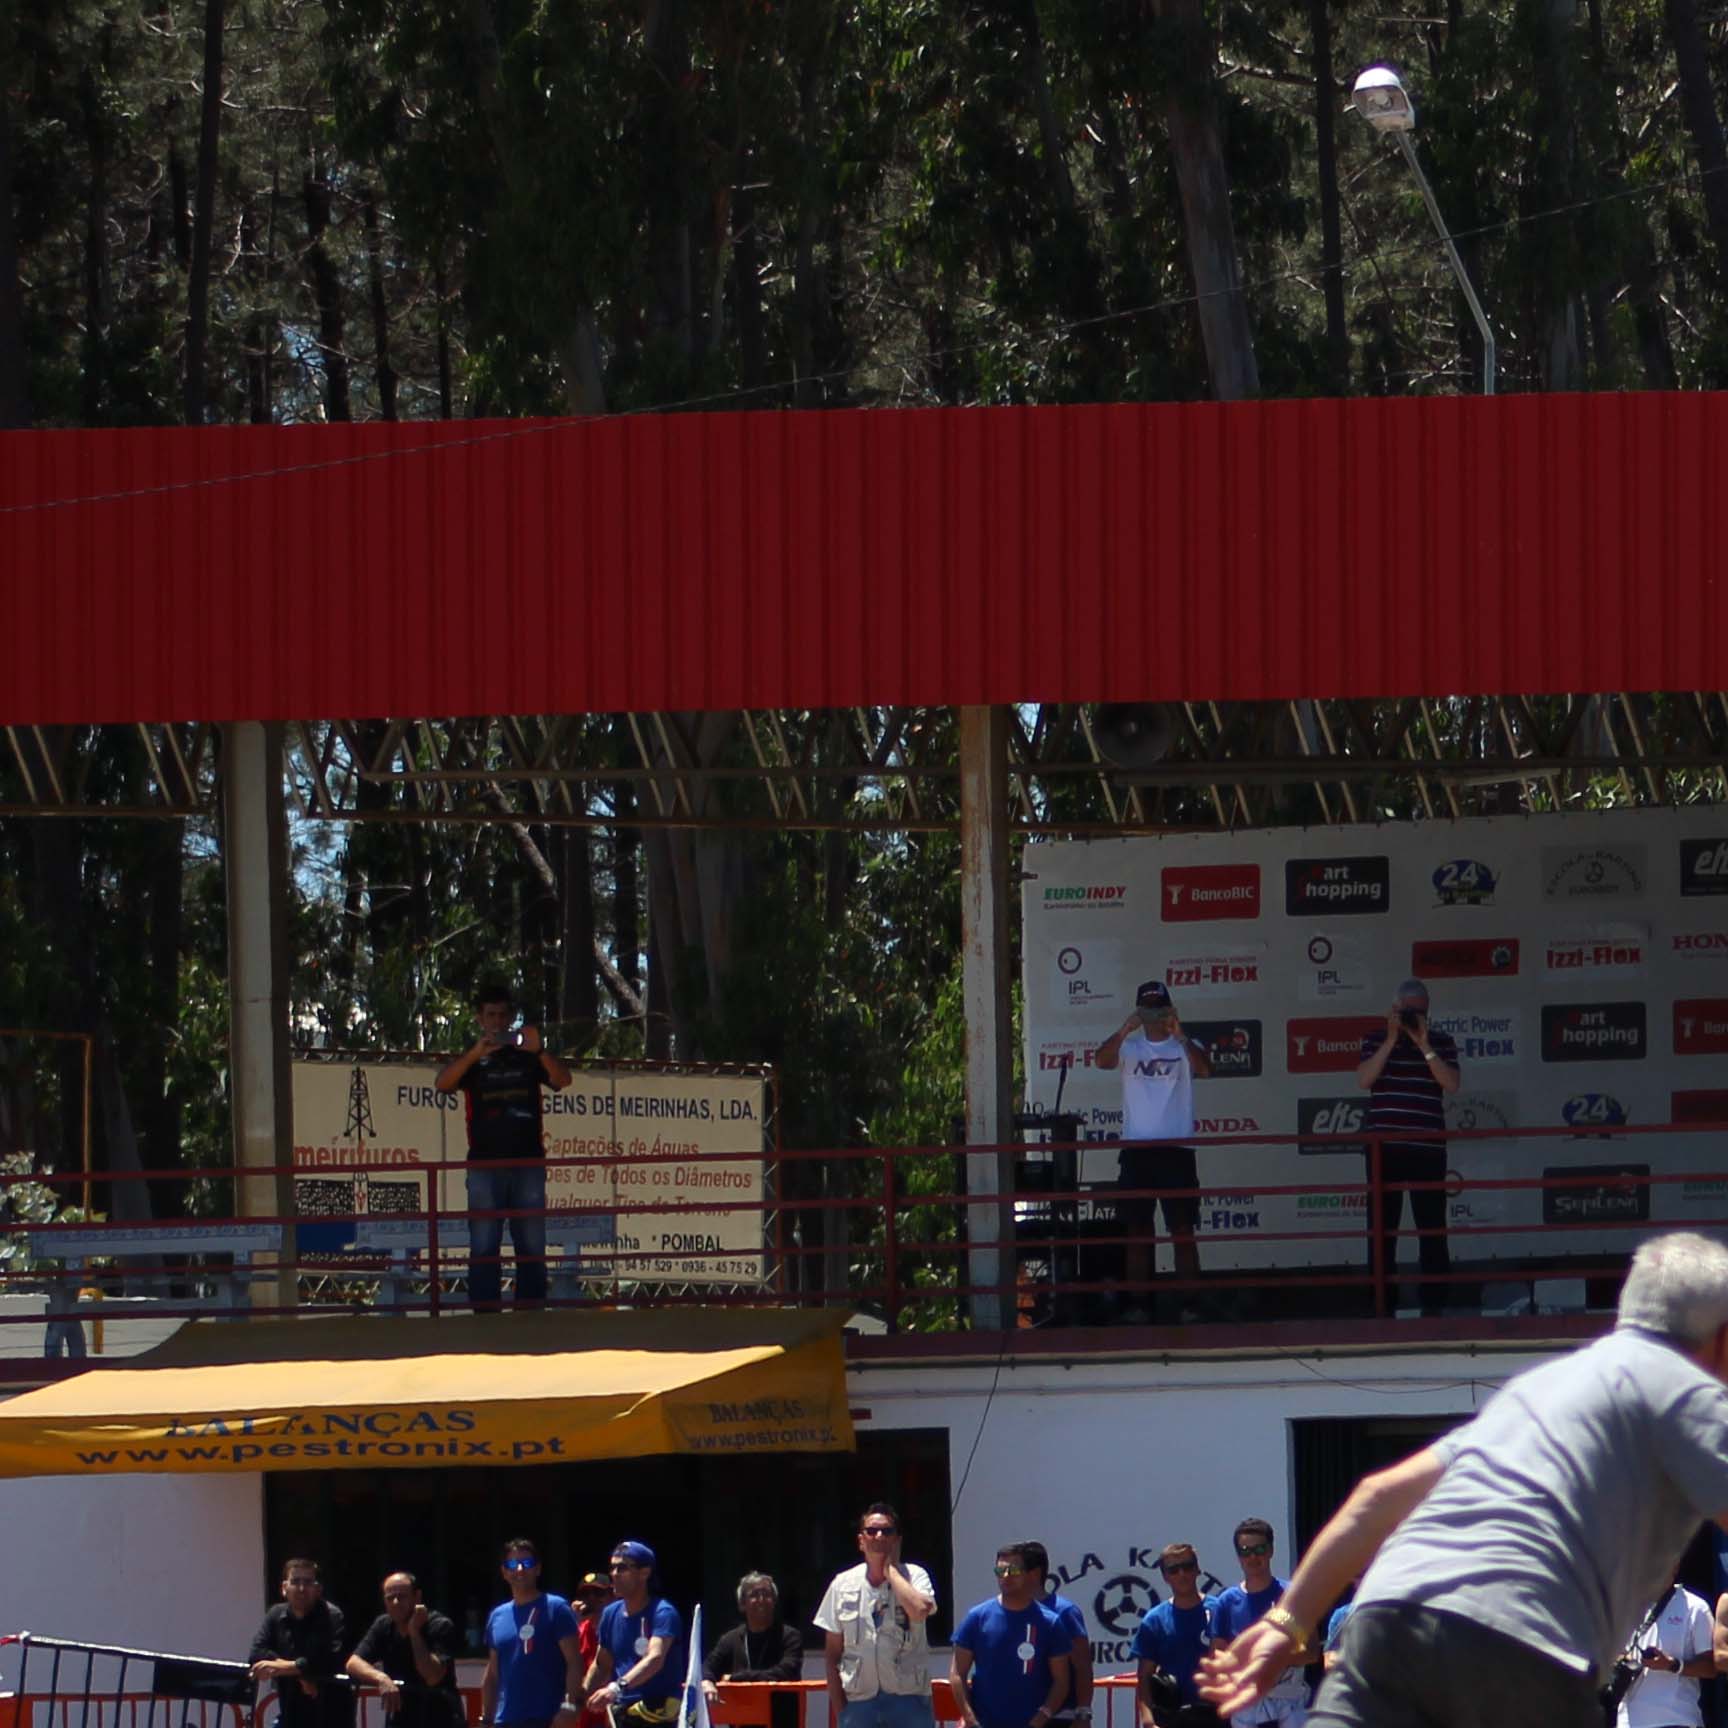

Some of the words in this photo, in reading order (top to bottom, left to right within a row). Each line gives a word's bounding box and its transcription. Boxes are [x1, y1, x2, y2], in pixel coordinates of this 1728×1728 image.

[1311, 864, 1350, 881] art
[1441, 864, 1480, 888] 24
[1044, 886, 1127, 900] EUROINDY
[1191, 885, 1256, 902] BancoBIC
[1297, 881, 1382, 901] hopping
[1471, 1015, 1512, 1033] Power
[1568, 1010, 1607, 1025] art
[1553, 1026, 1639, 1046] hopping
[398, 1086, 459, 1111] FUROS
[592, 1096, 616, 1117] DE
[620, 1097, 715, 1123] MEIRINHAS,
[720, 1099, 758, 1121] LDA.
[1572, 1099, 1609, 1122] 24
[1092, 1107, 1124, 1125] Powe
[629, 1136, 647, 1155] de
[577, 1165, 596, 1184] de
[603, 1165, 647, 1185] Todos
[652, 1171, 671, 1185] os
[675, 1166, 752, 1188] Diâmetros
[661, 1233, 725, 1250] POMBAL
[76, 1436, 566, 1465] www.pestronix.pt
